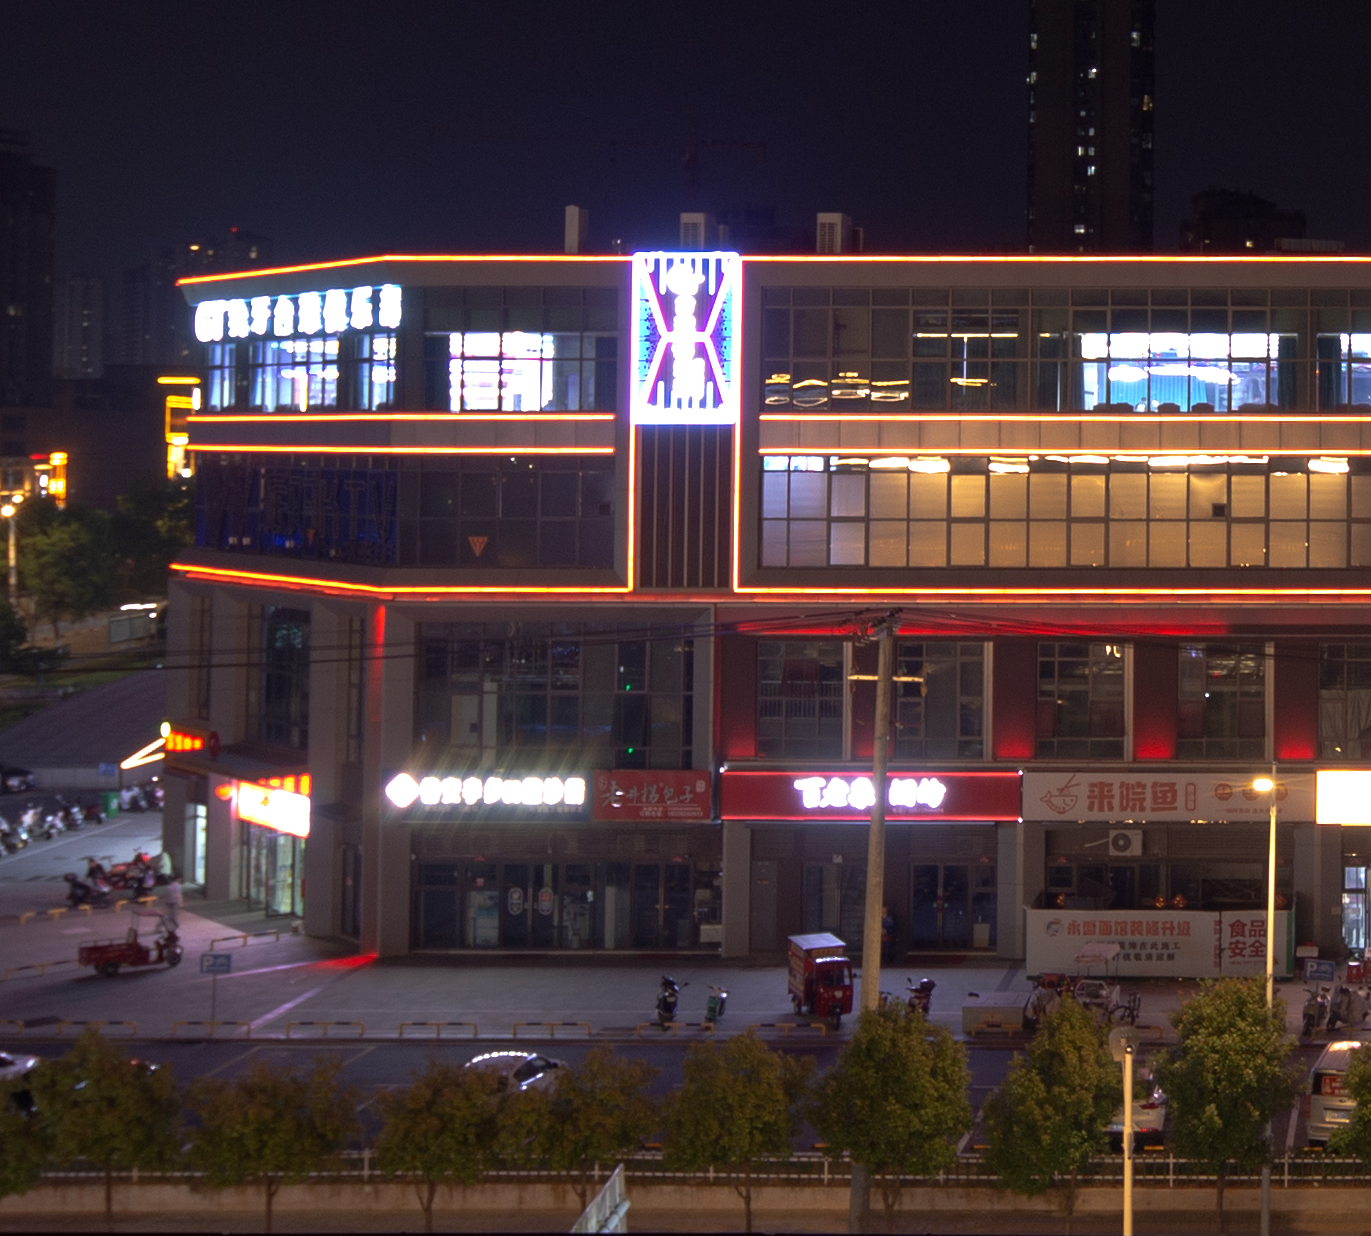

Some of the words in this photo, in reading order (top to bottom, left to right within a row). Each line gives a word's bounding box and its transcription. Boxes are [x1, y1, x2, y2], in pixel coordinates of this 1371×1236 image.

[1229, 919, 1267, 938] 食品
[1228, 940, 1267, 959] 安全
[203, 956, 214, 971] P
[1306, 961, 1318, 977] P
